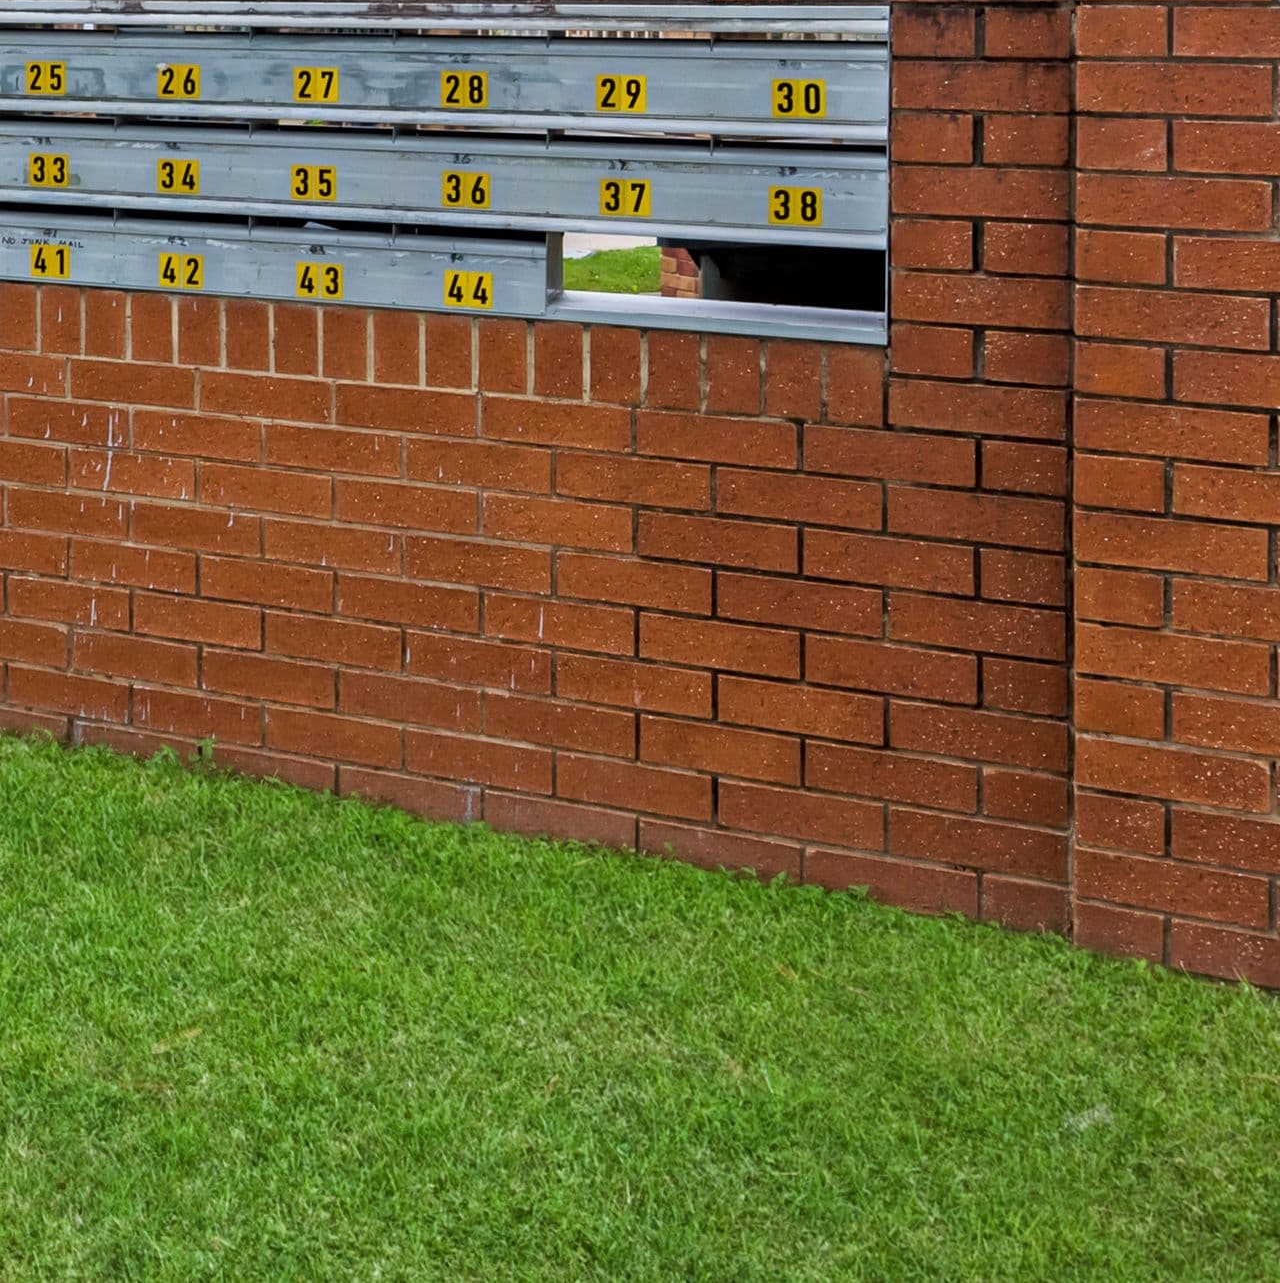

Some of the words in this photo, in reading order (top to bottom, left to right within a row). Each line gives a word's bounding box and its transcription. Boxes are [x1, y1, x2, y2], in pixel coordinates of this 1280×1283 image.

[29, 64, 62, 91] 25
[161, 67, 196, 95] 26
[298, 70, 334, 99] 27
[445, 74, 484, 104] 28
[600, 77, 641, 109] 29
[777, 82, 821, 115] 30
[33, 156, 65, 184] 33
[161, 161, 196, 191] 34
[295, 167, 332, 197] 35
[446, 173, 486, 205] 36
[604, 181, 646, 213] 37
[773, 189, 817, 222] 38
[34, 247, 65, 275] 41
[162, 256, 199, 285] 42
[299, 265, 339, 295] 43
[448, 274, 488, 305] 44
